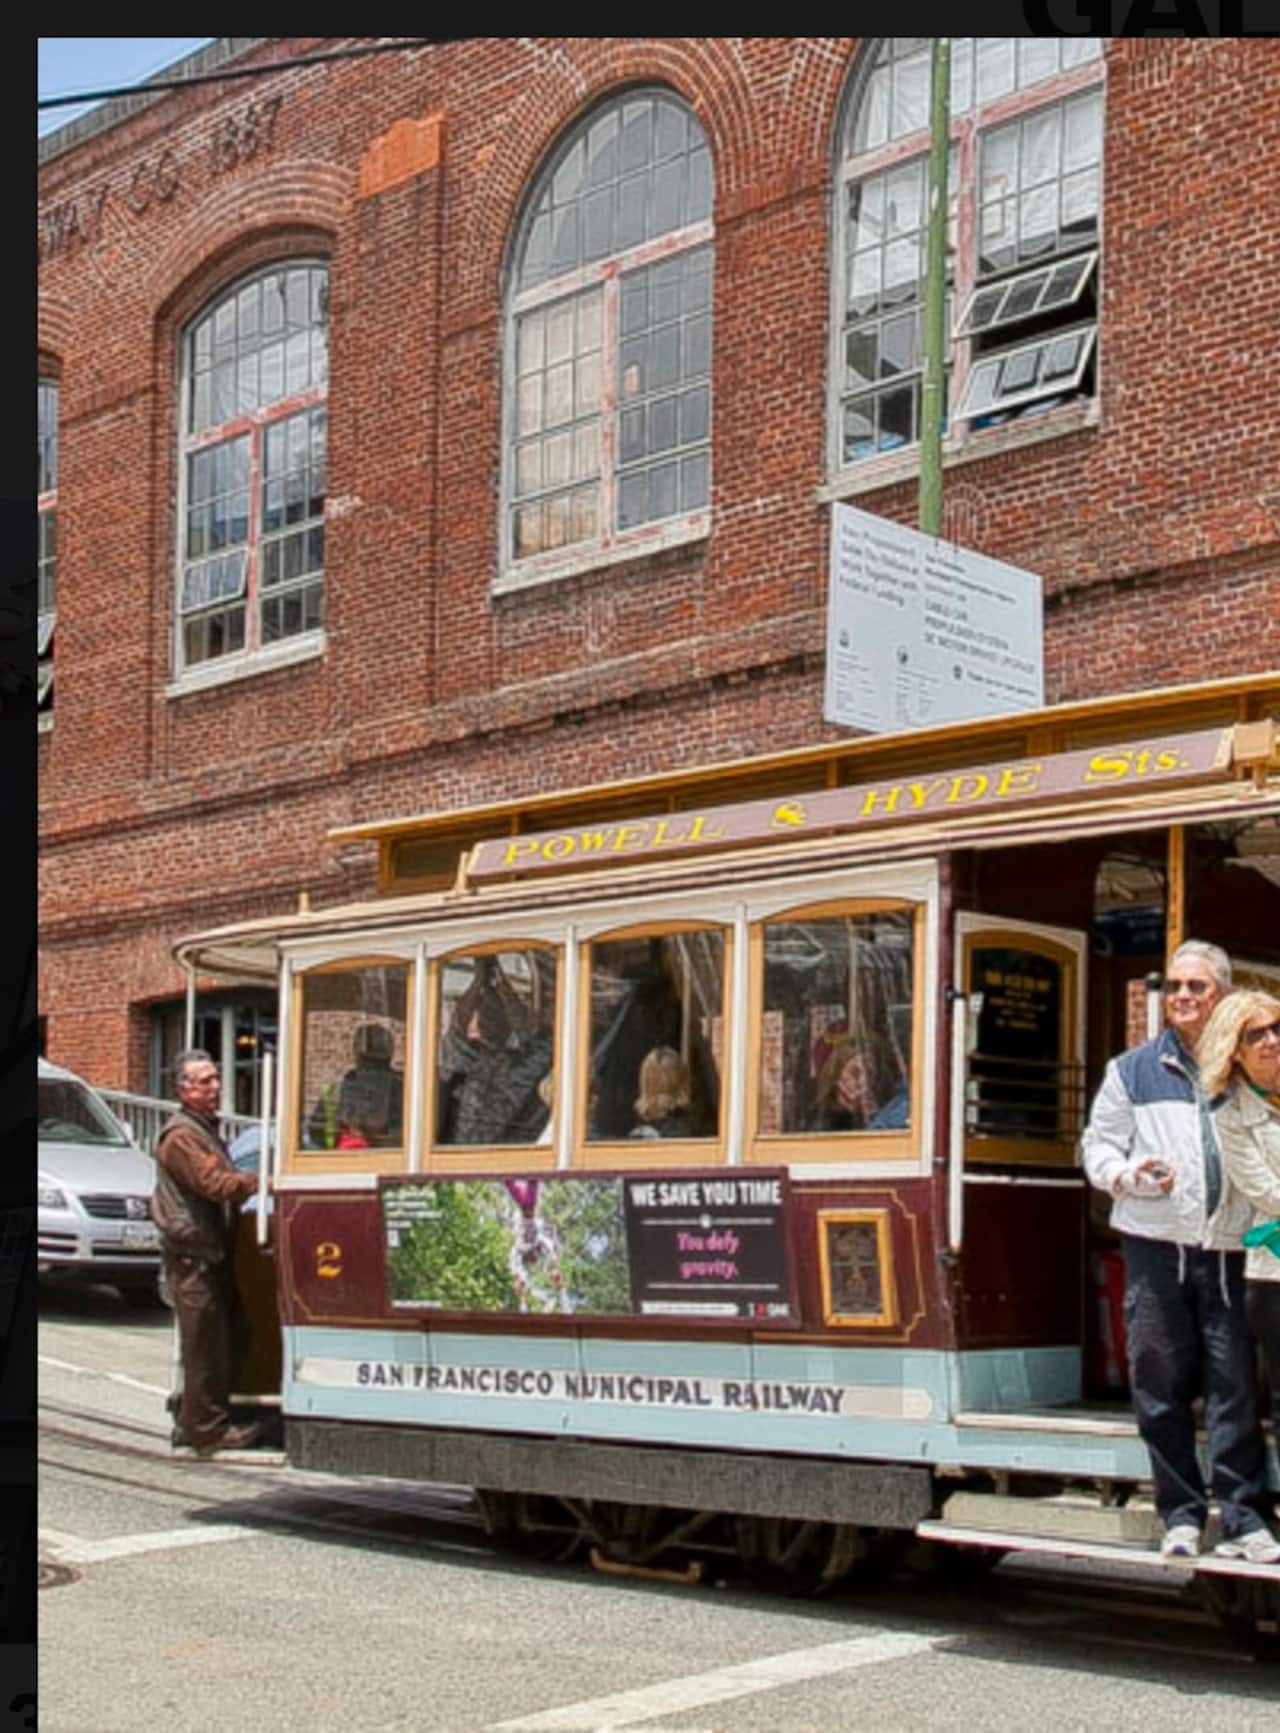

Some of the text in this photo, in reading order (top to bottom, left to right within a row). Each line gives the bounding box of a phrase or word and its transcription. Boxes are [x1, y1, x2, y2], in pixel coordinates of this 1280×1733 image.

[502, 748, 1192, 866] POWELL & HYDE Sts.
[629, 1179, 783, 1207] WE SAVE YOU TIME
[316, 1241, 343, 1278] 2
[676, 1229, 740, 1255] You defy
[356, 1362, 845, 1413] SAN FRANCISCO MUNICIPAL RAILWAY
